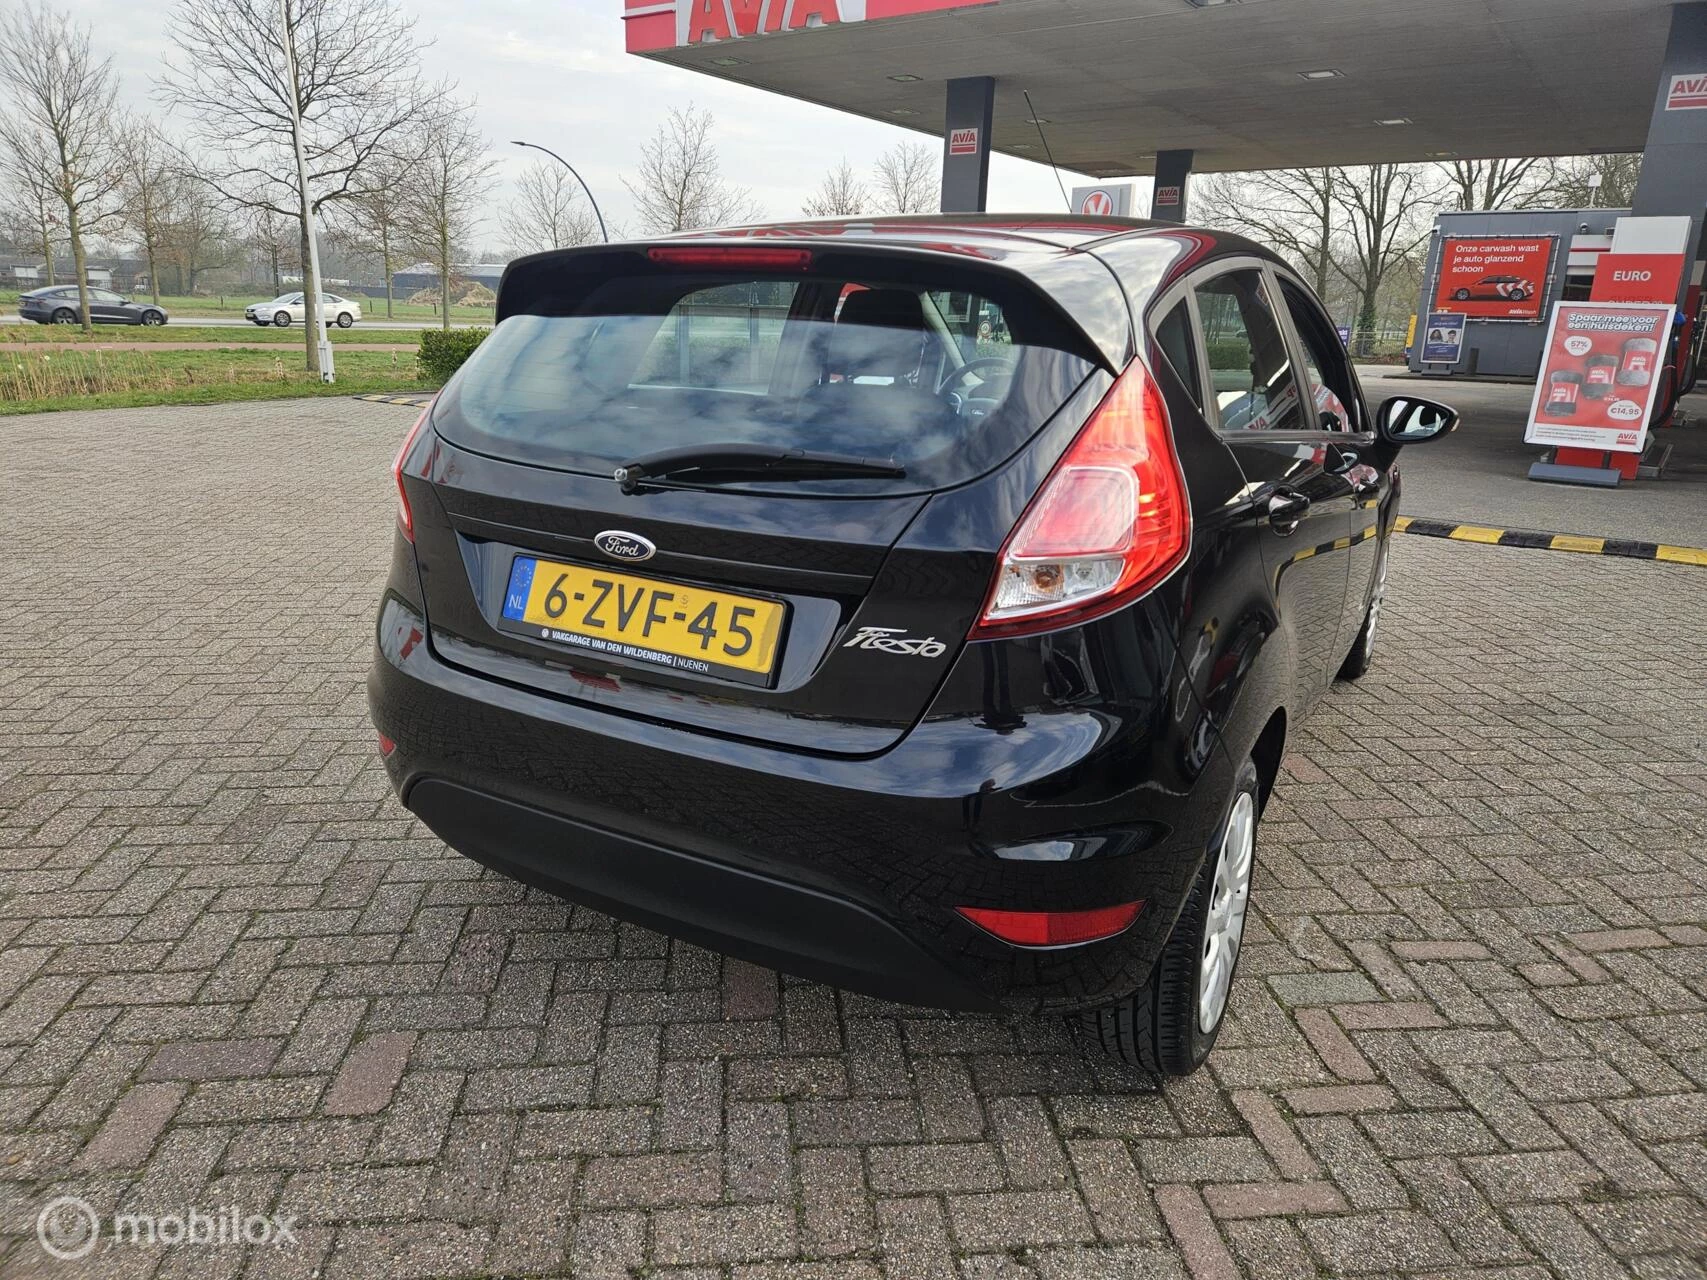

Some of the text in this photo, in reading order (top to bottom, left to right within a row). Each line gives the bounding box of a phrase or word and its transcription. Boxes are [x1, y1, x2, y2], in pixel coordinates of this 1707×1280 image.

[1671, 75, 1707, 94] AVI
[952, 130, 976, 144] AVIA
[1158, 187, 1178, 198] AVIA
[1455, 244, 1539, 253] Onze carwash wast
[1453, 254, 1525, 264] je auto glanzend
[1452, 265, 1484, 273] schoon
[1613, 270, 1652, 281] EURO
[1568, 313, 1659, 324] Spaar mee voor
[1568, 322, 1654, 332] een huisdeken!
[1617, 431, 1638, 441] AVIA
[605, 536, 639, 556] Ford
[508, 573, 756, 657] NL 6-ZVF-45
[842, 626, 947, 658] Fiesta
[552, 630, 709, 673] VAKGARAGE VAN DEN WILDENBERG NUENEN
